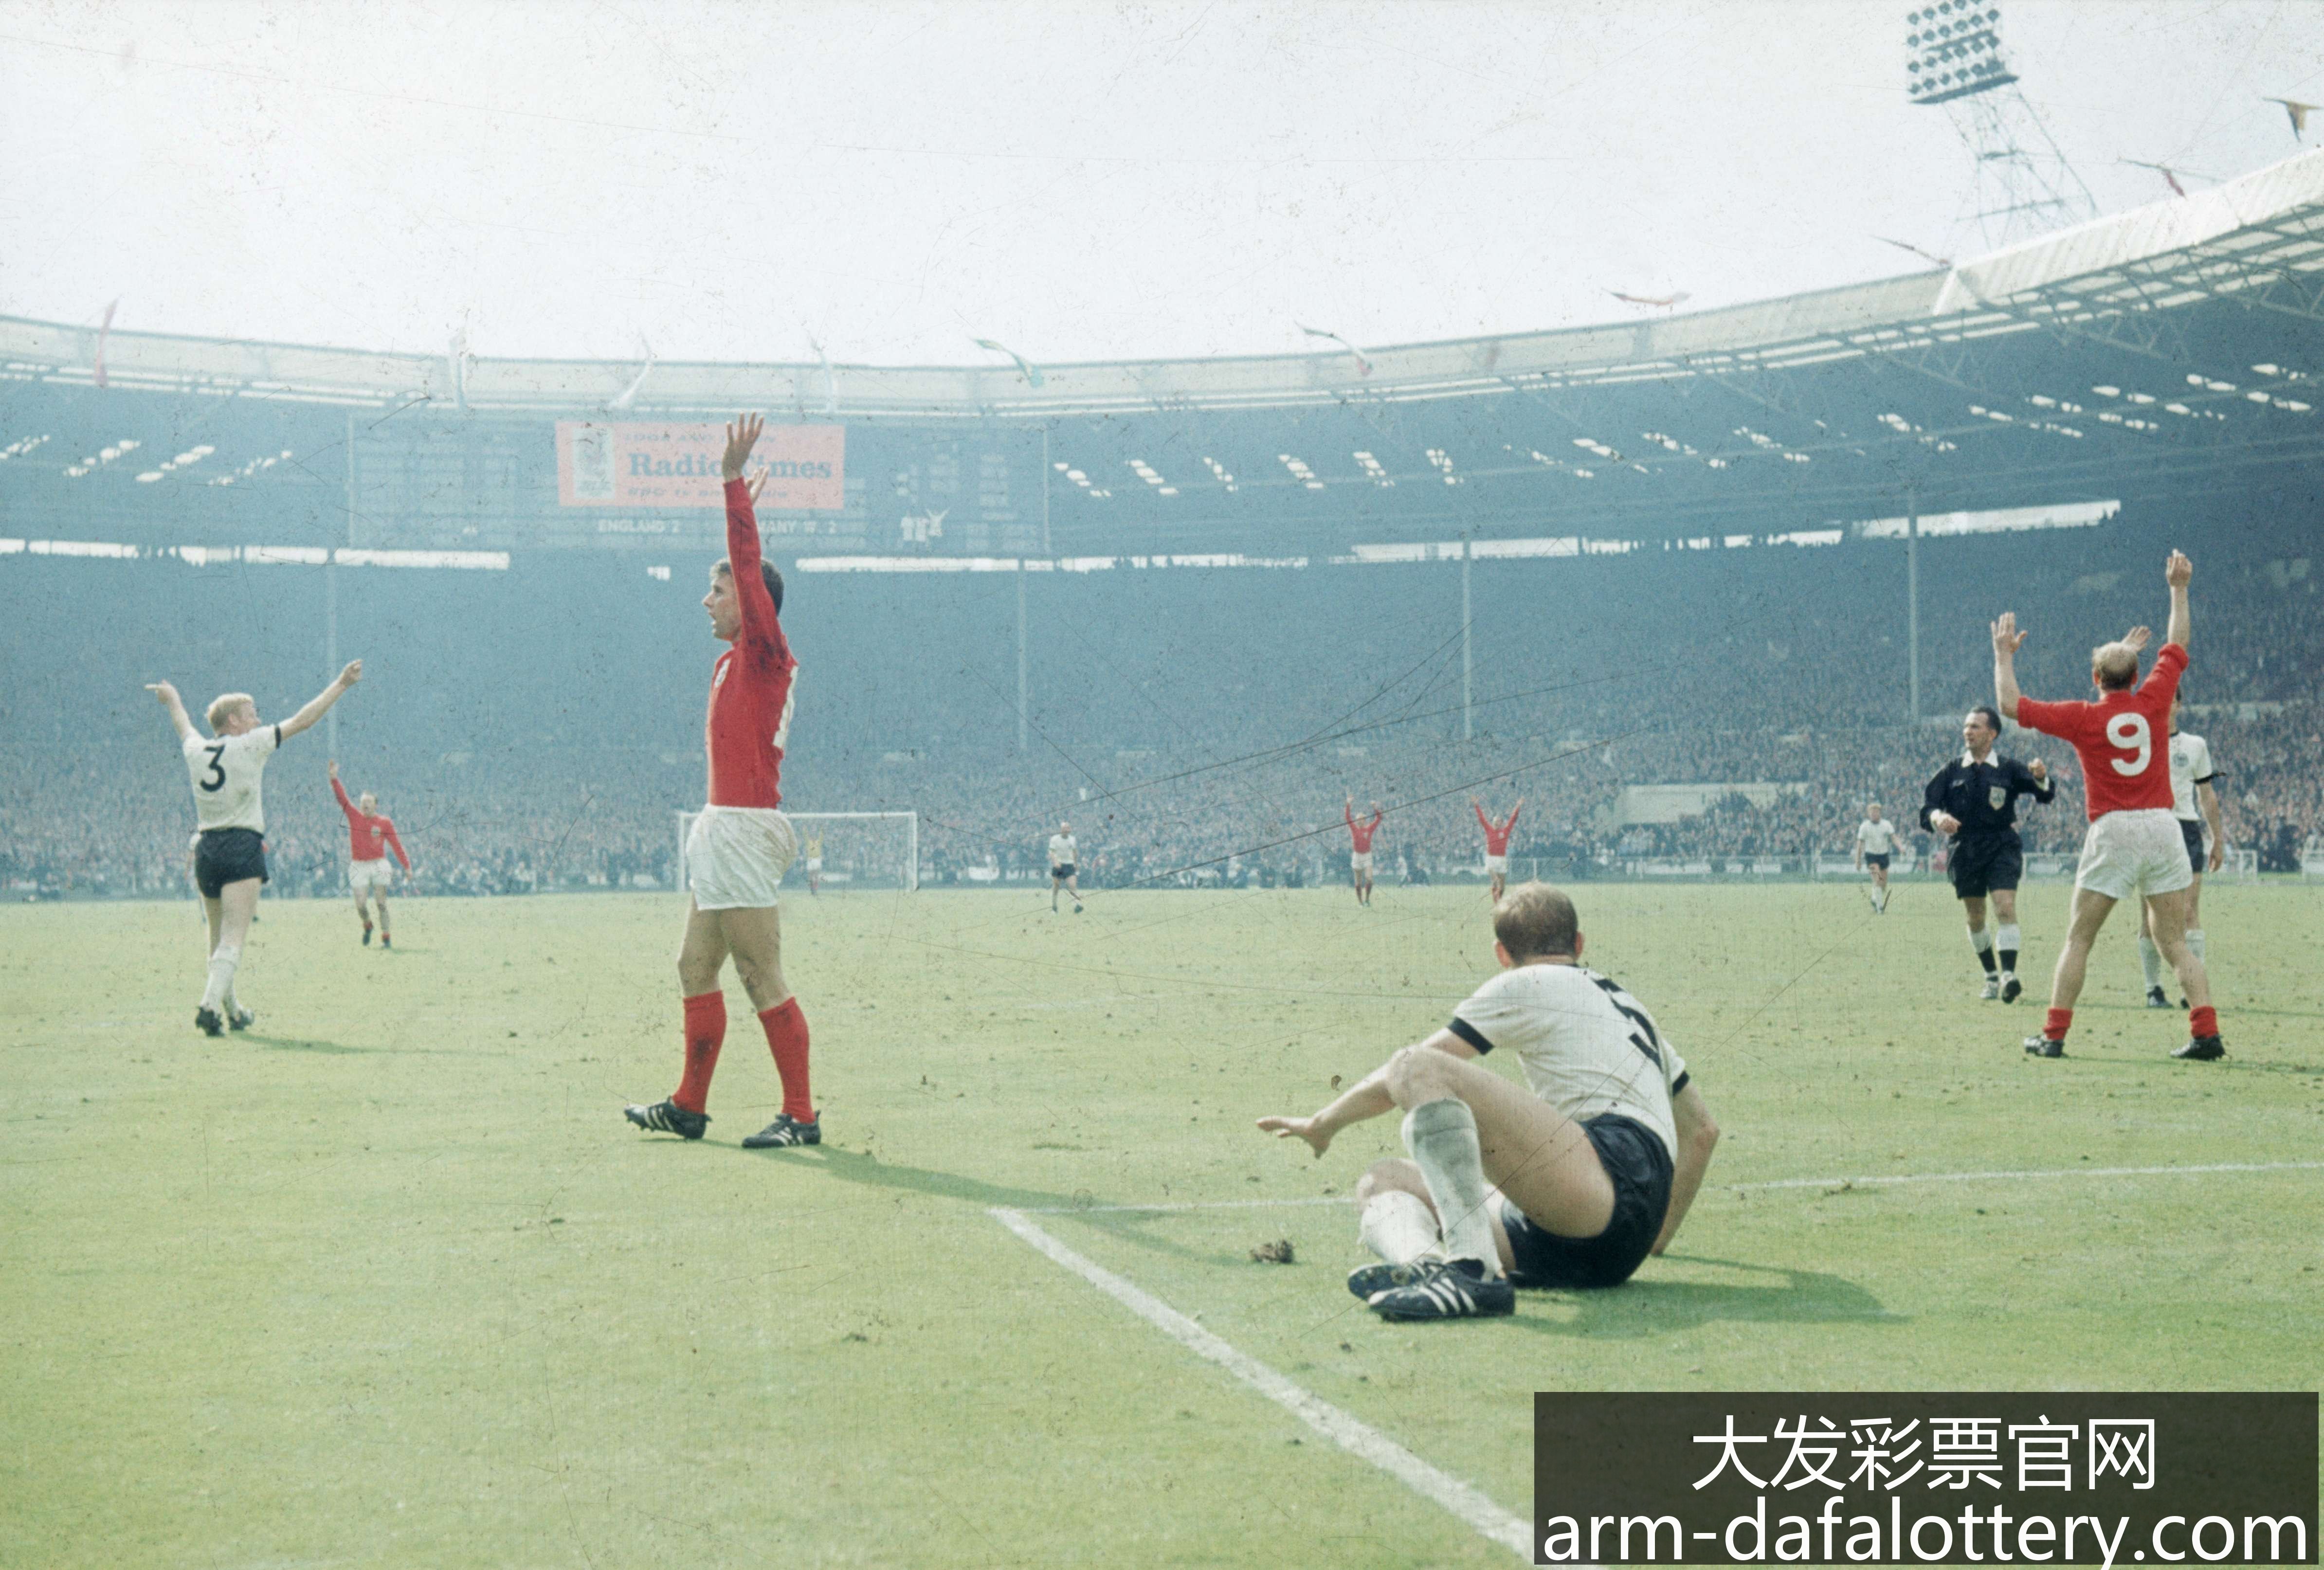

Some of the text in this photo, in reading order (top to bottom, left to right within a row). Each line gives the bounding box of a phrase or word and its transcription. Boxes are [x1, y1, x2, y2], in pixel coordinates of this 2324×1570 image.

[627, 452, 723, 477] Radio
[598, 519, 665, 533] ENGLAND
[672, 520, 680, 533] 2
[828, 521, 836, 534] 2
[2106, 712, 2151, 776] 9
[200, 743, 226, 792] 3
